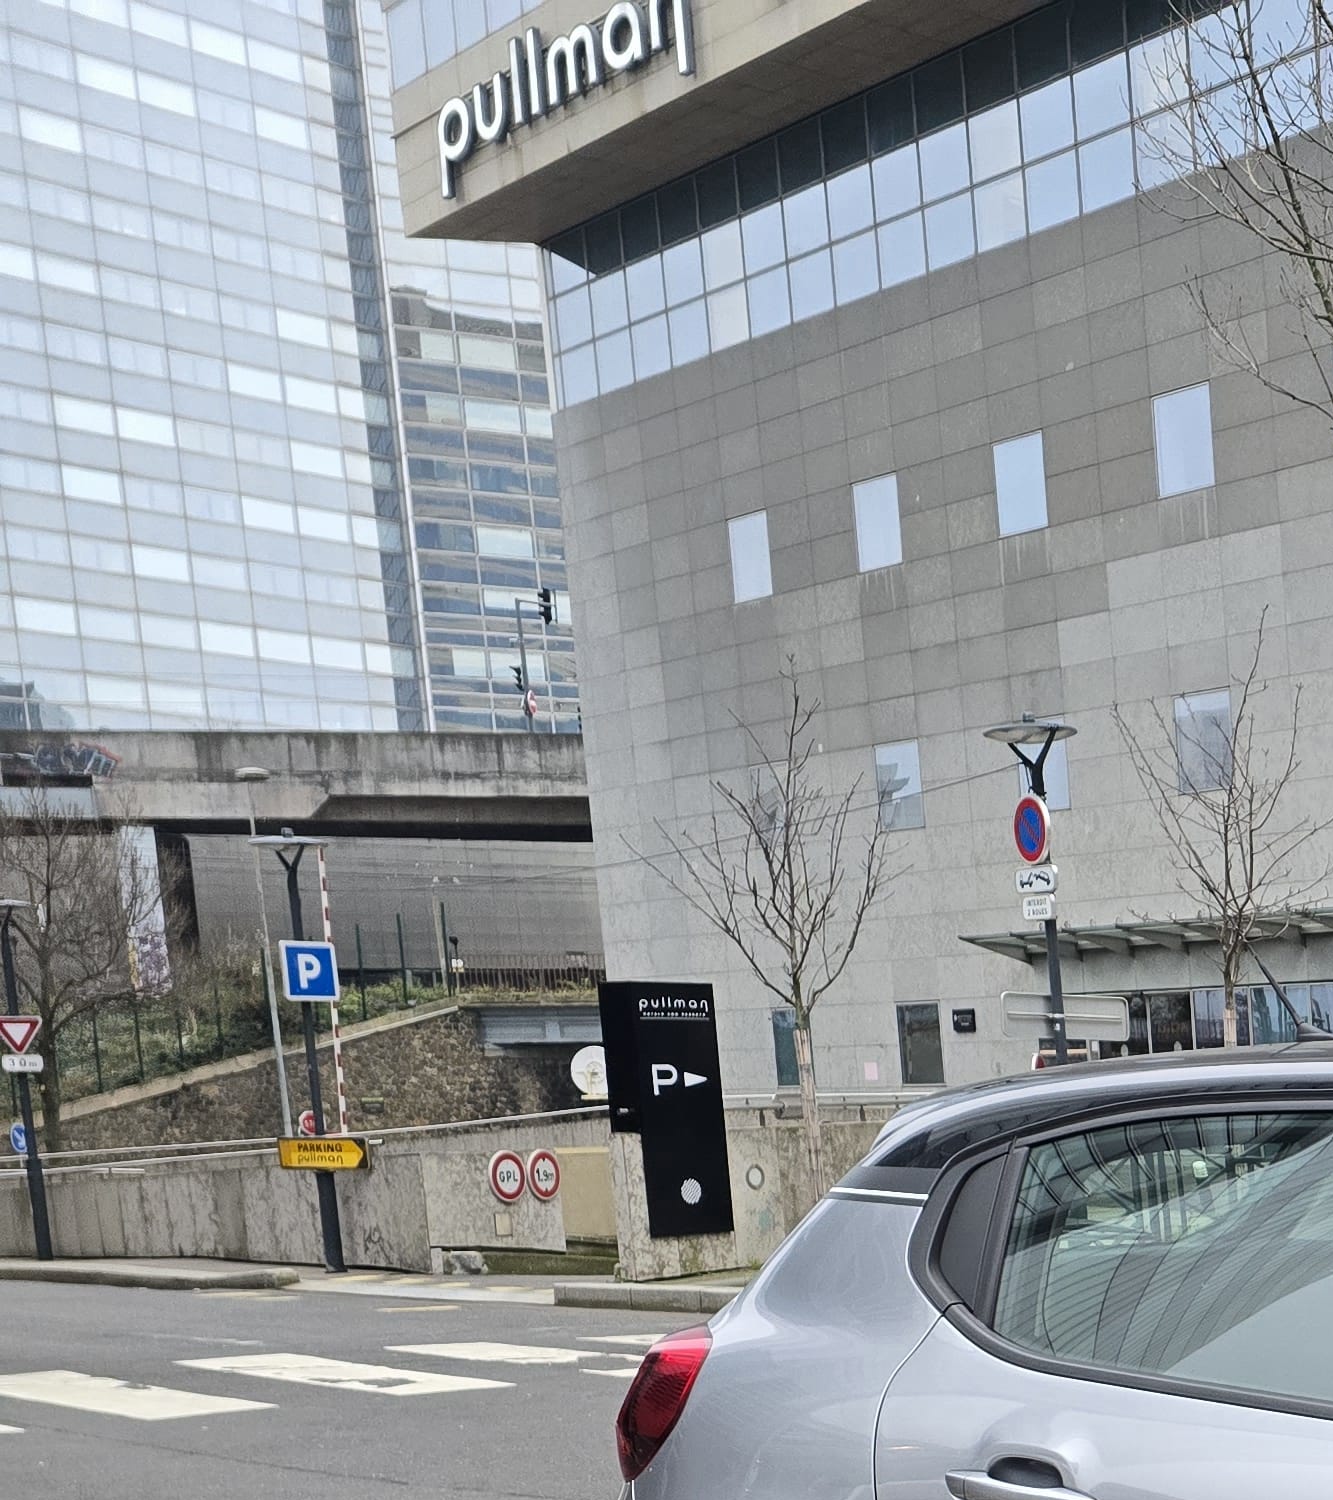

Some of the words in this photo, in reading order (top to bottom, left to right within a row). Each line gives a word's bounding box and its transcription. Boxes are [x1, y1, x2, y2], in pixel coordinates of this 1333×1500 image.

[437, 0, 696, 199] pullman
[297, 953, 321, 989] P
[639, 996, 709, 1013] pullman
[651, 1063, 678, 1096] P
[297, 1142, 343, 1153] PARKING
[297, 1153, 344, 1165] pullman
[500, 1170, 518, 1182] GPL
